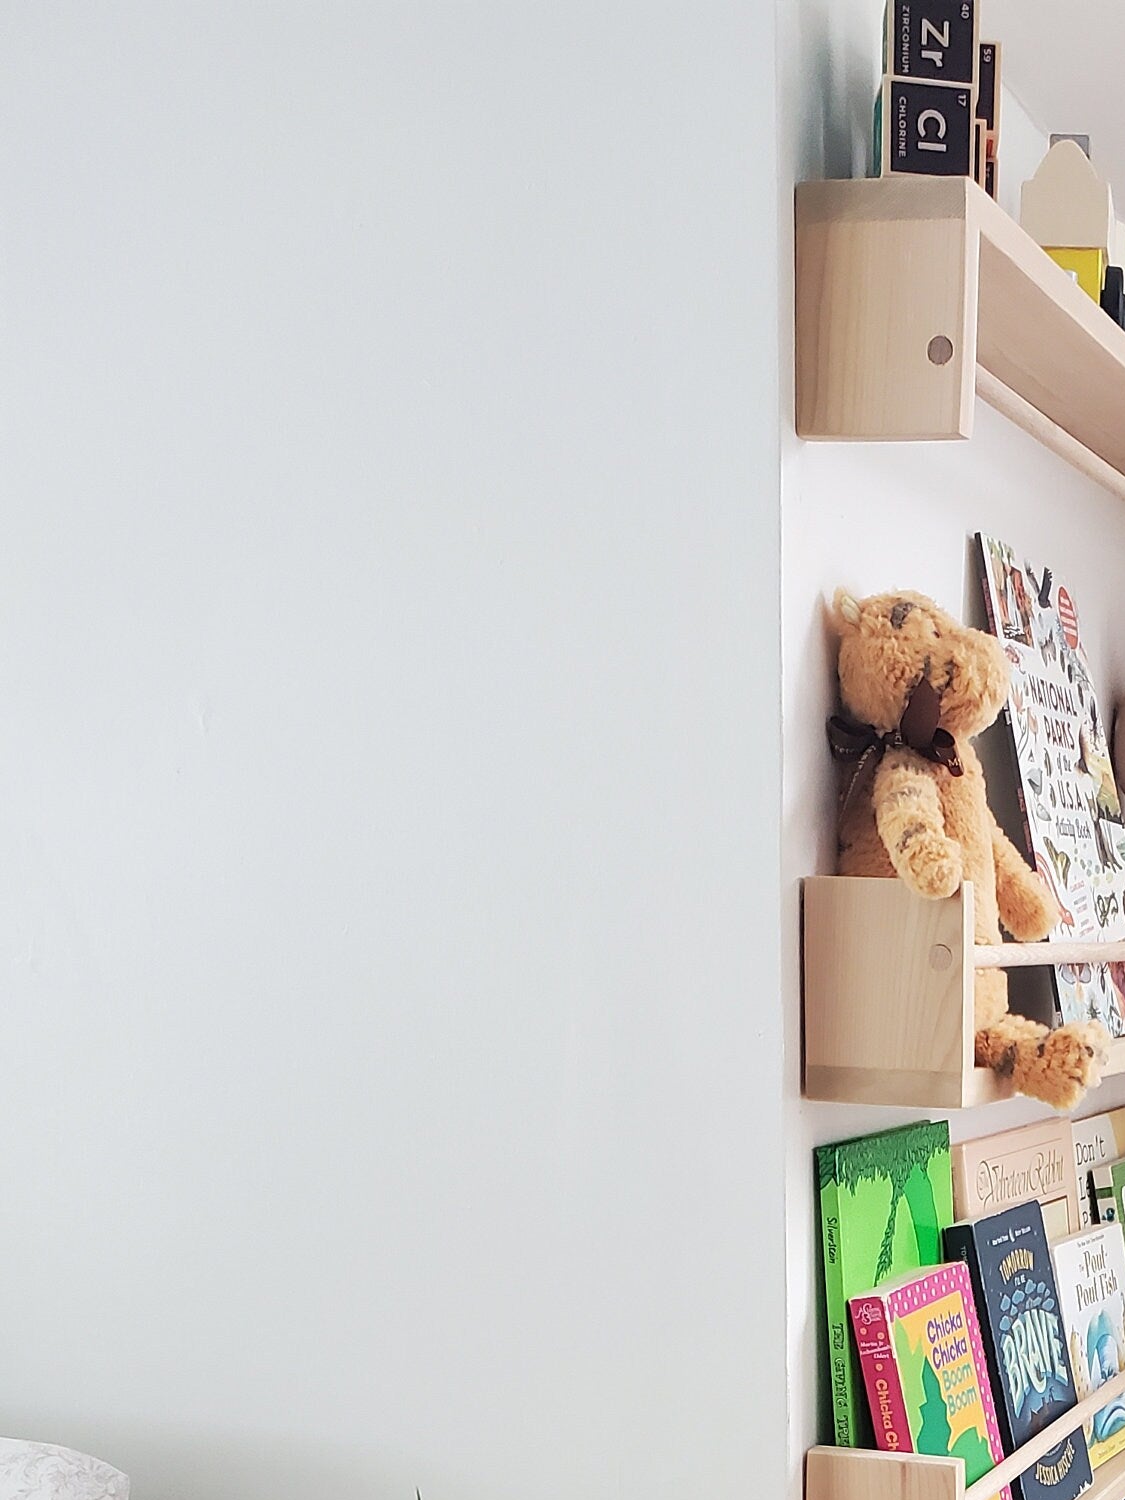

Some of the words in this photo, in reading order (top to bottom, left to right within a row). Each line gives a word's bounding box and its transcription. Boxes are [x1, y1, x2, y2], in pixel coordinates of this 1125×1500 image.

[961, 3, 970, 19] 40
[902, 5, 910, 73] ZIRCONIUM
[921, 18, 950, 68] Zr
[957, 94, 967, 107] 17
[898, 96, 906, 158] CHLORINE
[917, 109, 947, 153] Cl
[1028, 673, 1078, 717] NATIONAL
[1043, 715, 1075, 750] PARKS
[1057, 780, 1087, 812] U.S.A.
[1028, 1149, 1064, 1195] Rabbit
[1075, 1135, 1106, 1165] Don't
[826, 1217, 839, 1264] Silverstein
[999, 1248, 1034, 1286] TOMORROW
[1075, 1276, 1099, 1313] Pout
[1099, 1269, 1118, 1301] Fish
[927, 1310, 963, 1345] Chicka
[932, 1336, 968, 1370] Chicka
[1003, 1309, 1068, 1418] BRAVE
[834, 1357, 847, 1408] GIVING
[942, 1363, 973, 1391] Boom
[876, 1379, 893, 1429] Chicka
[947, 1386, 977, 1416] Boom
